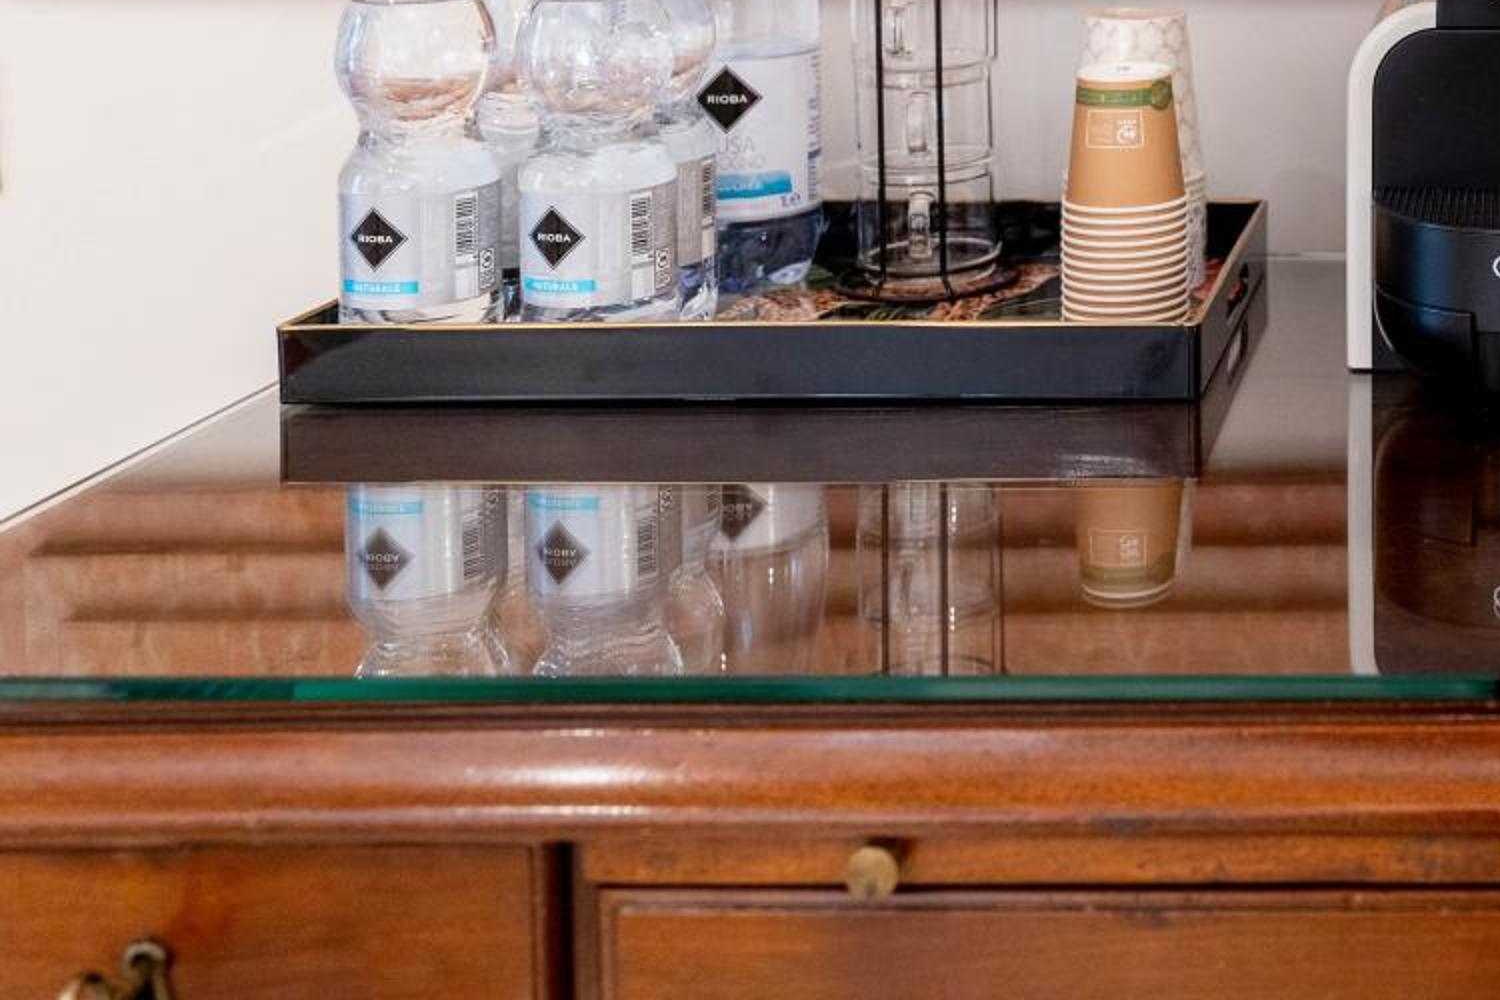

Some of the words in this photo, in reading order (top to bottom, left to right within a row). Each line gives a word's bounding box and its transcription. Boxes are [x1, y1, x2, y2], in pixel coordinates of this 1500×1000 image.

[707, 94, 748, 104] RIOBA
[357, 234, 394, 243] RIOBA
[537, 233, 571, 243] RIOBA
